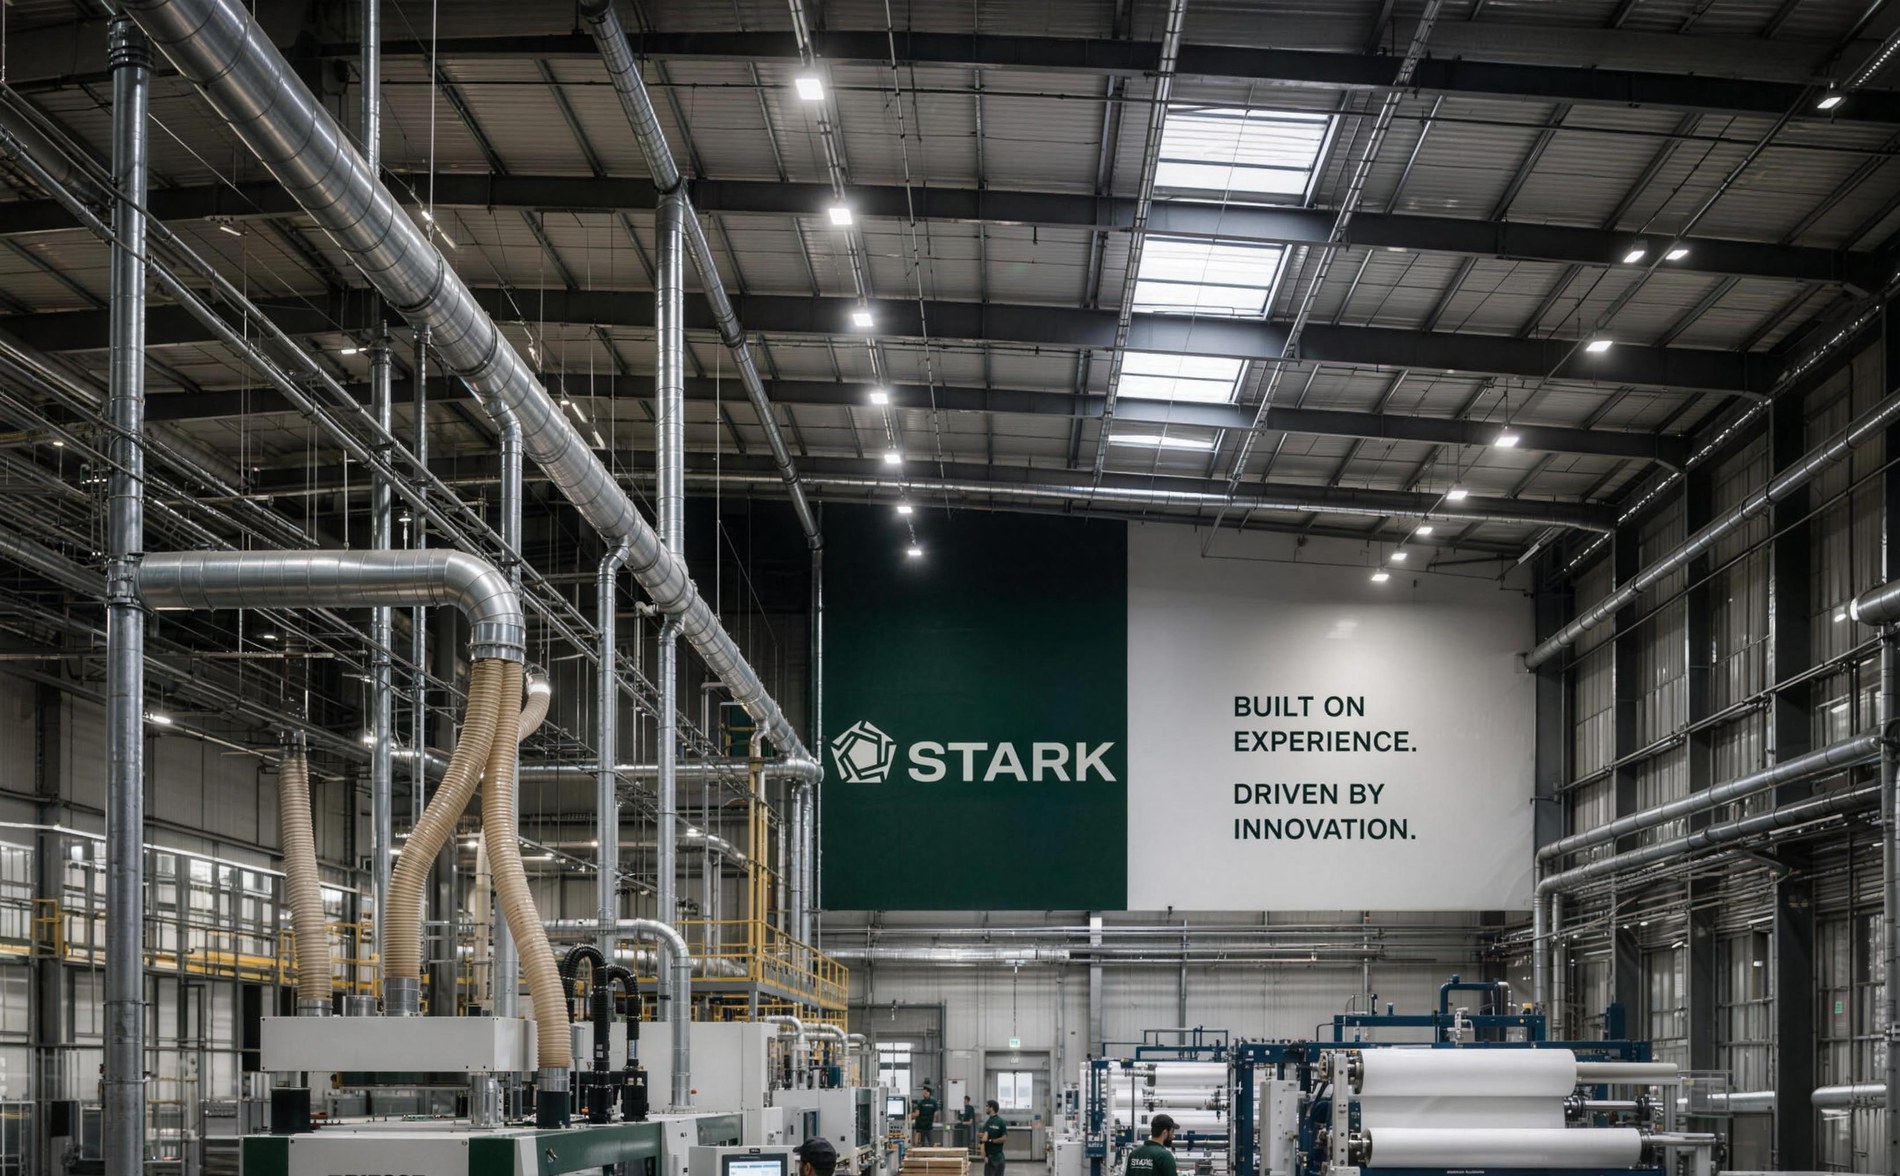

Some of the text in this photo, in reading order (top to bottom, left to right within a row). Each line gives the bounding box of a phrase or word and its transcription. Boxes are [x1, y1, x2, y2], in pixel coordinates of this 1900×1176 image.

[1234, 695, 1365, 718] BUILT ON
[1234, 730, 1417, 753] EXPERIENCE.
[907, 740, 1117, 783] STARK
[1234, 783, 1385, 805] DRIVEN BY
[1234, 818, 1416, 840] INNOVATION.
